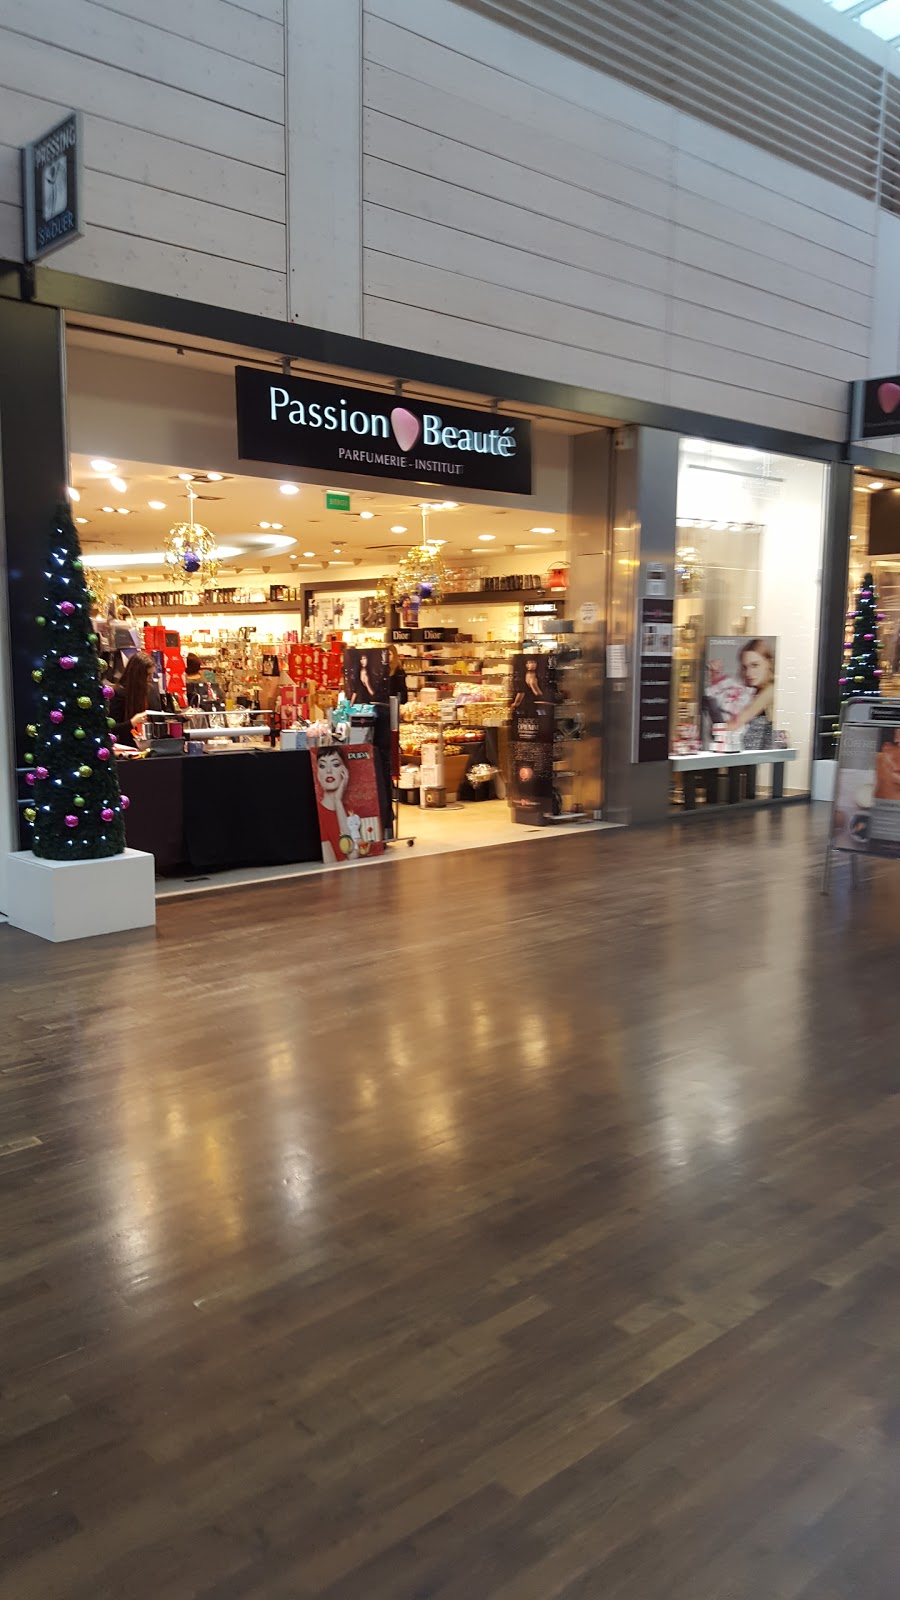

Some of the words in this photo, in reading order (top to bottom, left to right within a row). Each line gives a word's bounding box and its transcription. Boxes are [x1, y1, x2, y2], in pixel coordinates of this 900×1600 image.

[38, 209, 74, 245] SADLER
[269, 385, 390, 439] Passion
[422, 414, 516, 457] Beauté
[338, 447, 407, 468] PARFUMERIE
[415, 458, 462, 475] INSTITUT
[392, 631, 409, 640] Dior
[424, 630, 441, 640] Dior
[347, 752, 370, 760] PUPA
